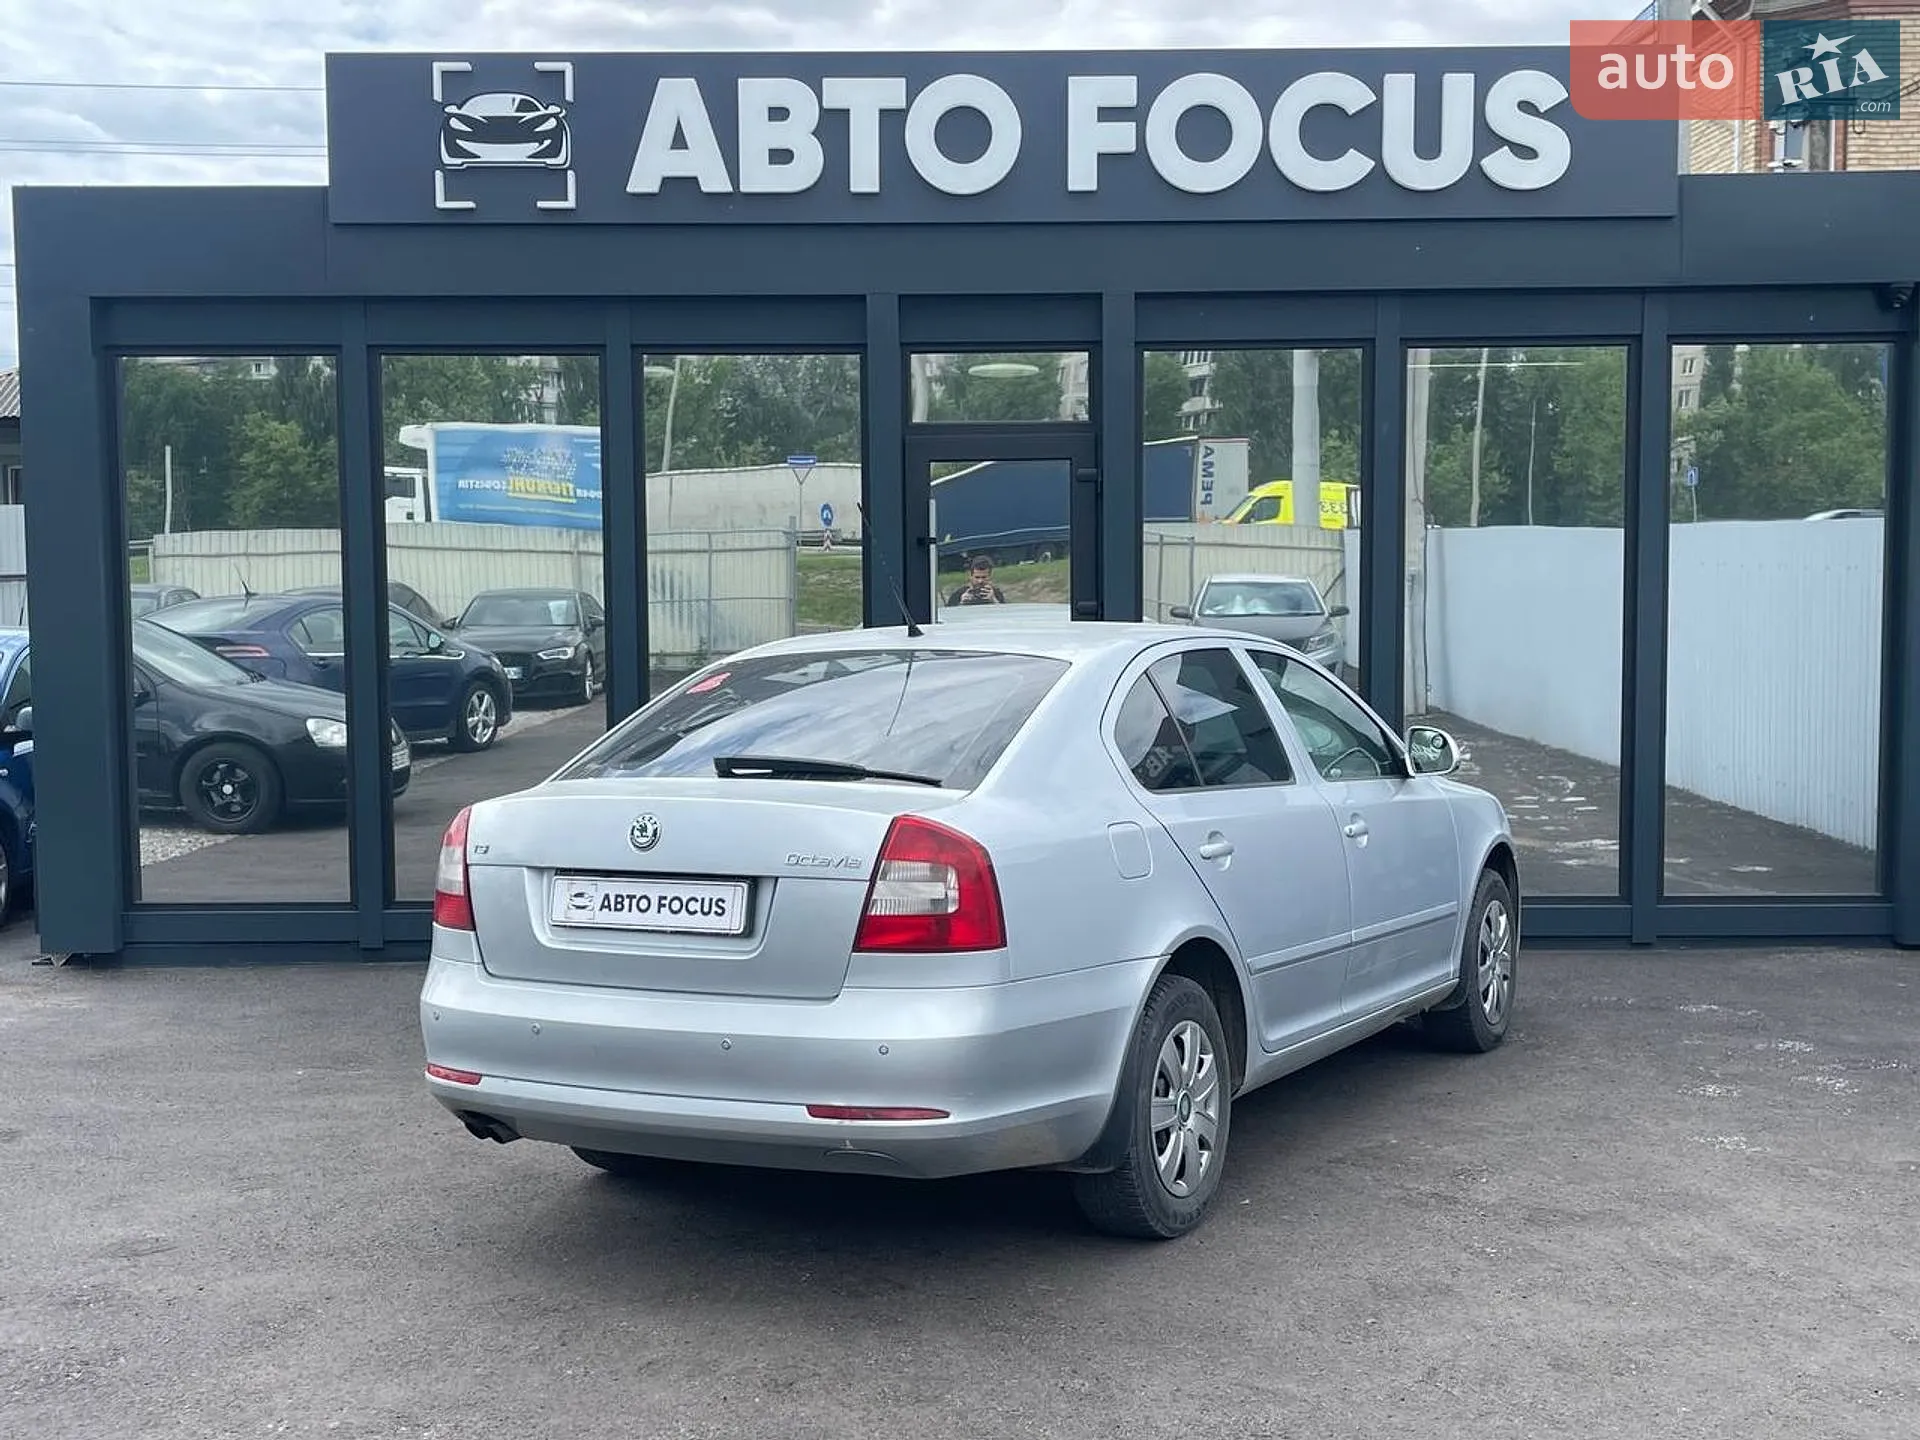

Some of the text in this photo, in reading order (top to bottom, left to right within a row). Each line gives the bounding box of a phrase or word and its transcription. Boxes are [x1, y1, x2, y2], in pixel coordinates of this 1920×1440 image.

[626, 69, 1572, 195] АВТО FOCUS
[784, 852, 862, 869] Octavia
[599, 893, 727, 917] АВТО FOCUS
